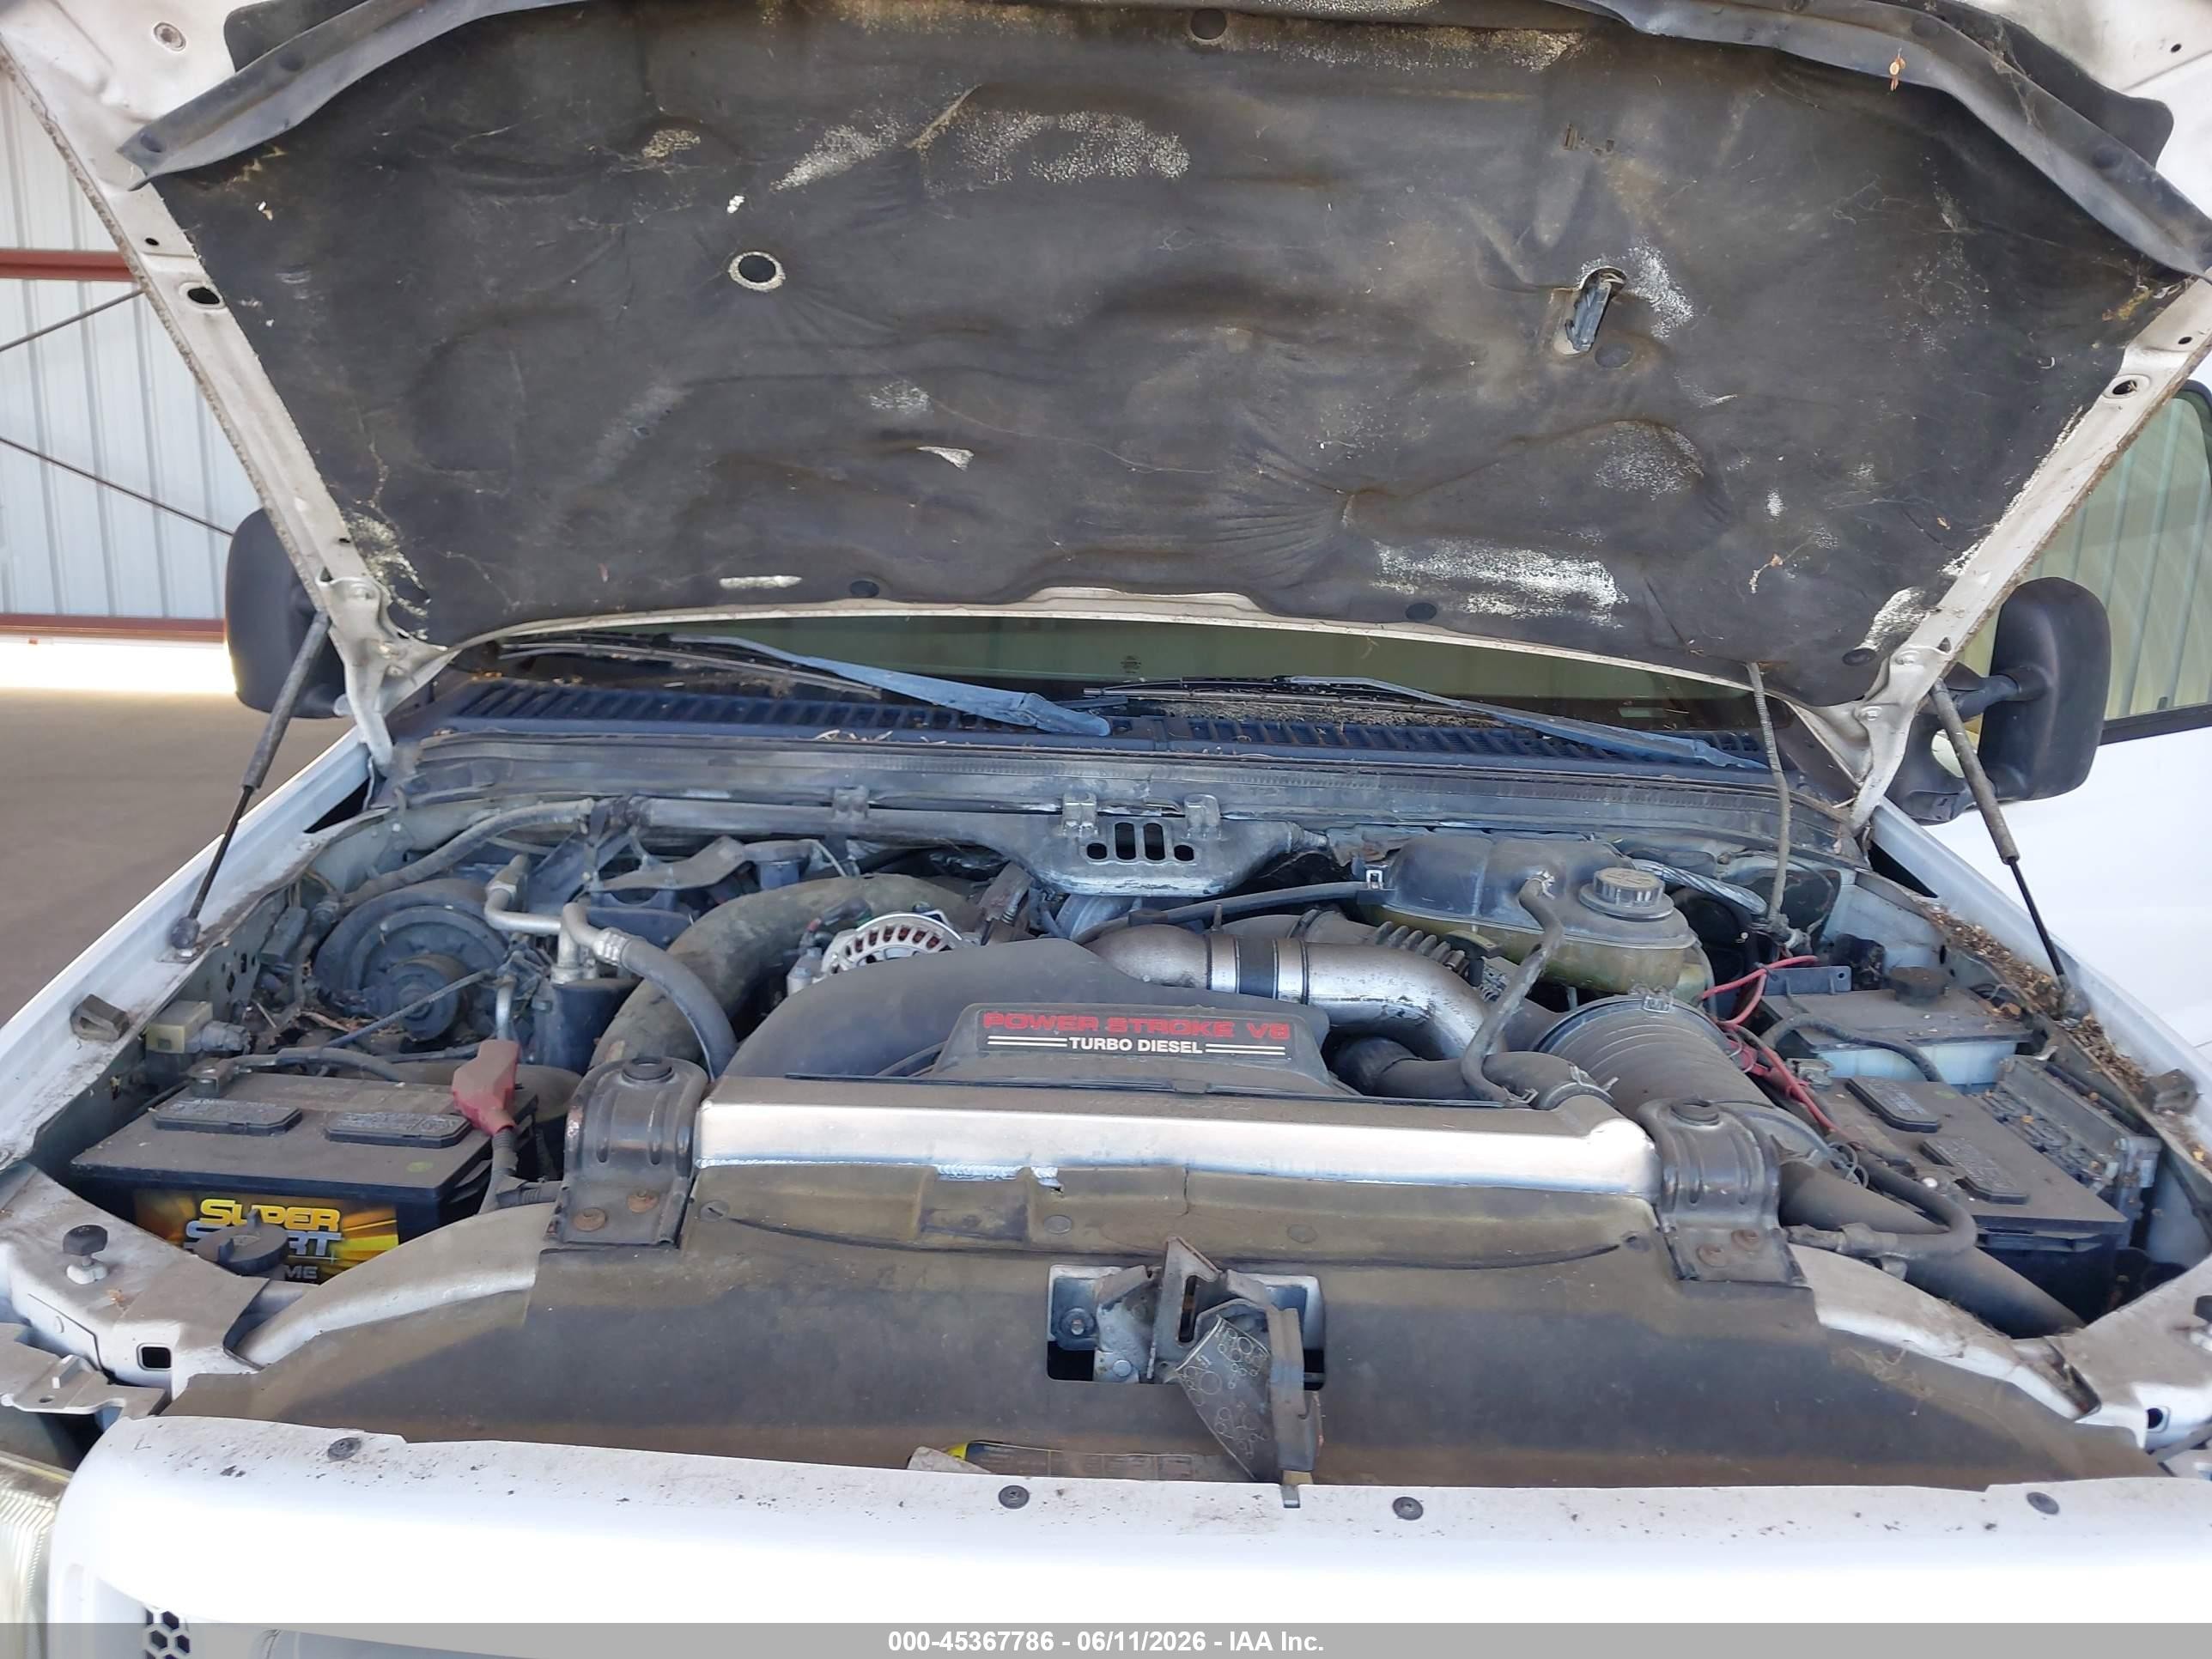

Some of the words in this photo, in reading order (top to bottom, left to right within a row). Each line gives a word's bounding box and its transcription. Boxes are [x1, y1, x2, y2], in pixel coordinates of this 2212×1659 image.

[982, 1012, 1100, 1032] POWER
[1107, 1016, 1236, 1038] STROKE
[1246, 1022, 1291, 1041] V8
[1068, 1036, 1133, 1052] TURBO
[1137, 1039, 1203, 1054] DIESEL
[198, 1198, 341, 1231] SUPER
